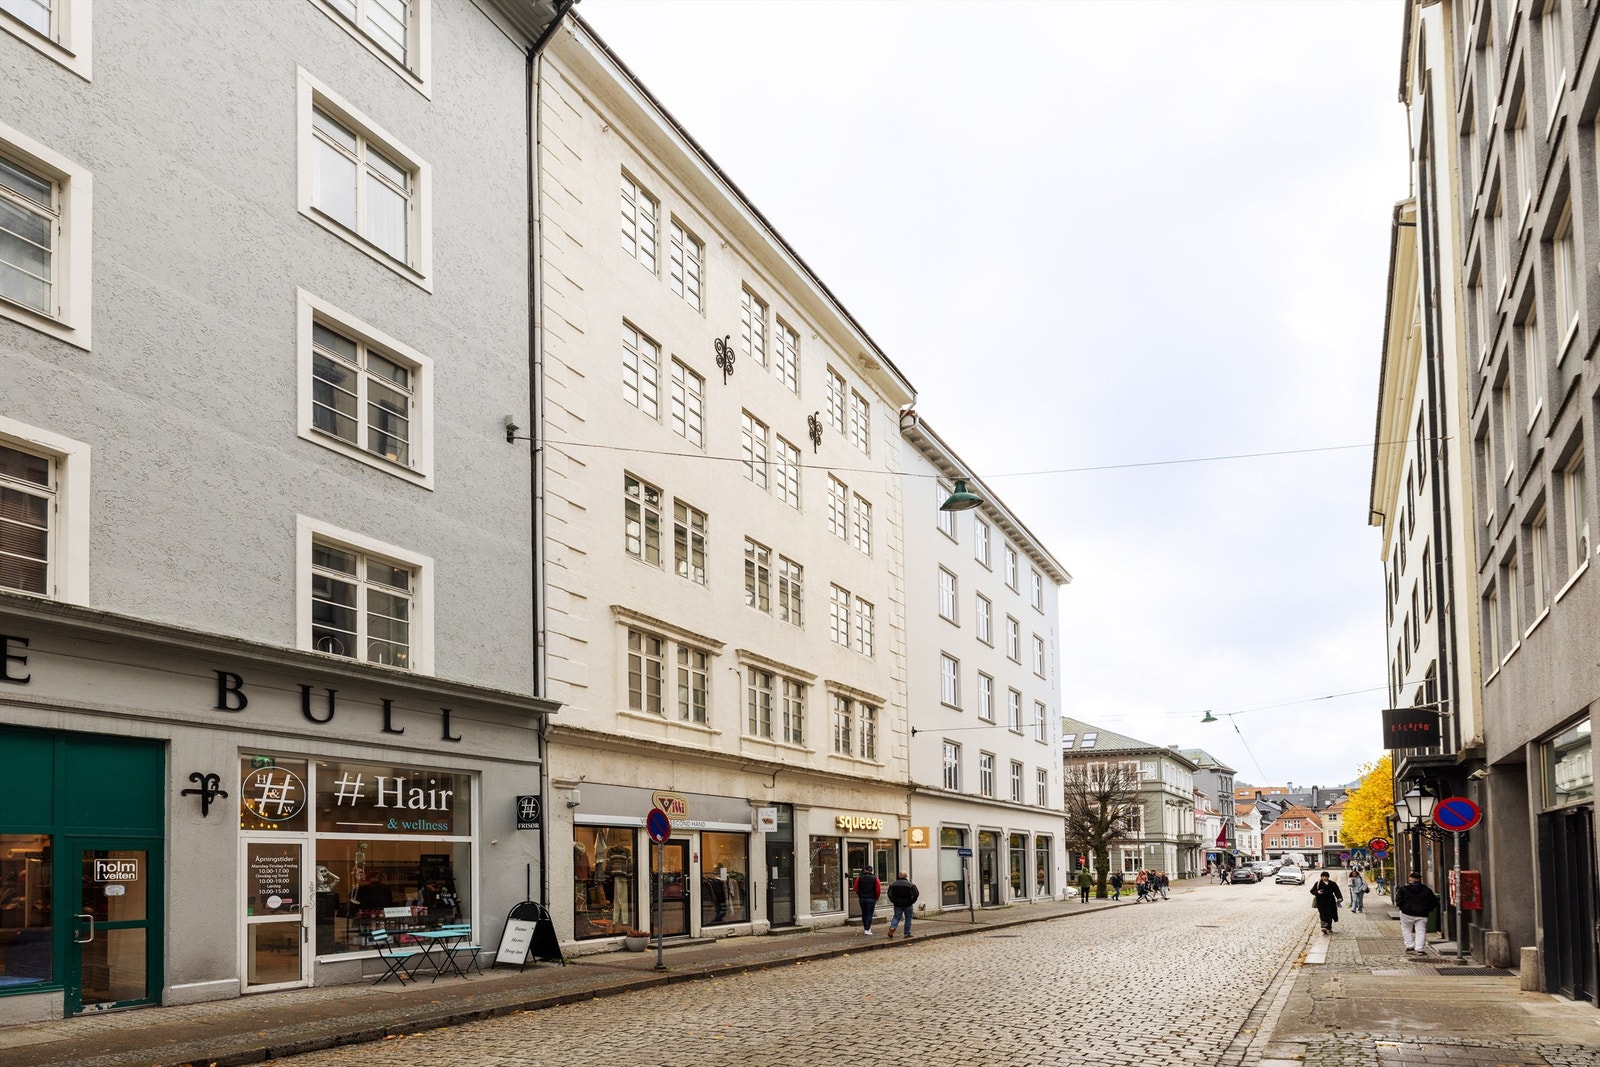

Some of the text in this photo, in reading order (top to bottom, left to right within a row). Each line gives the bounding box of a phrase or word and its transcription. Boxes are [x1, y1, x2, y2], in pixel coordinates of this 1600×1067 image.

[212, 669, 462, 743] BULL
[257, 774, 266, 784] H
[334, 772, 454, 812] # Hair
[387, 818, 449, 831] & wellness
[838, 815, 884, 833] squeeze
[97, 861, 136, 872] holm
[102, 872, 136, 880] veiten
